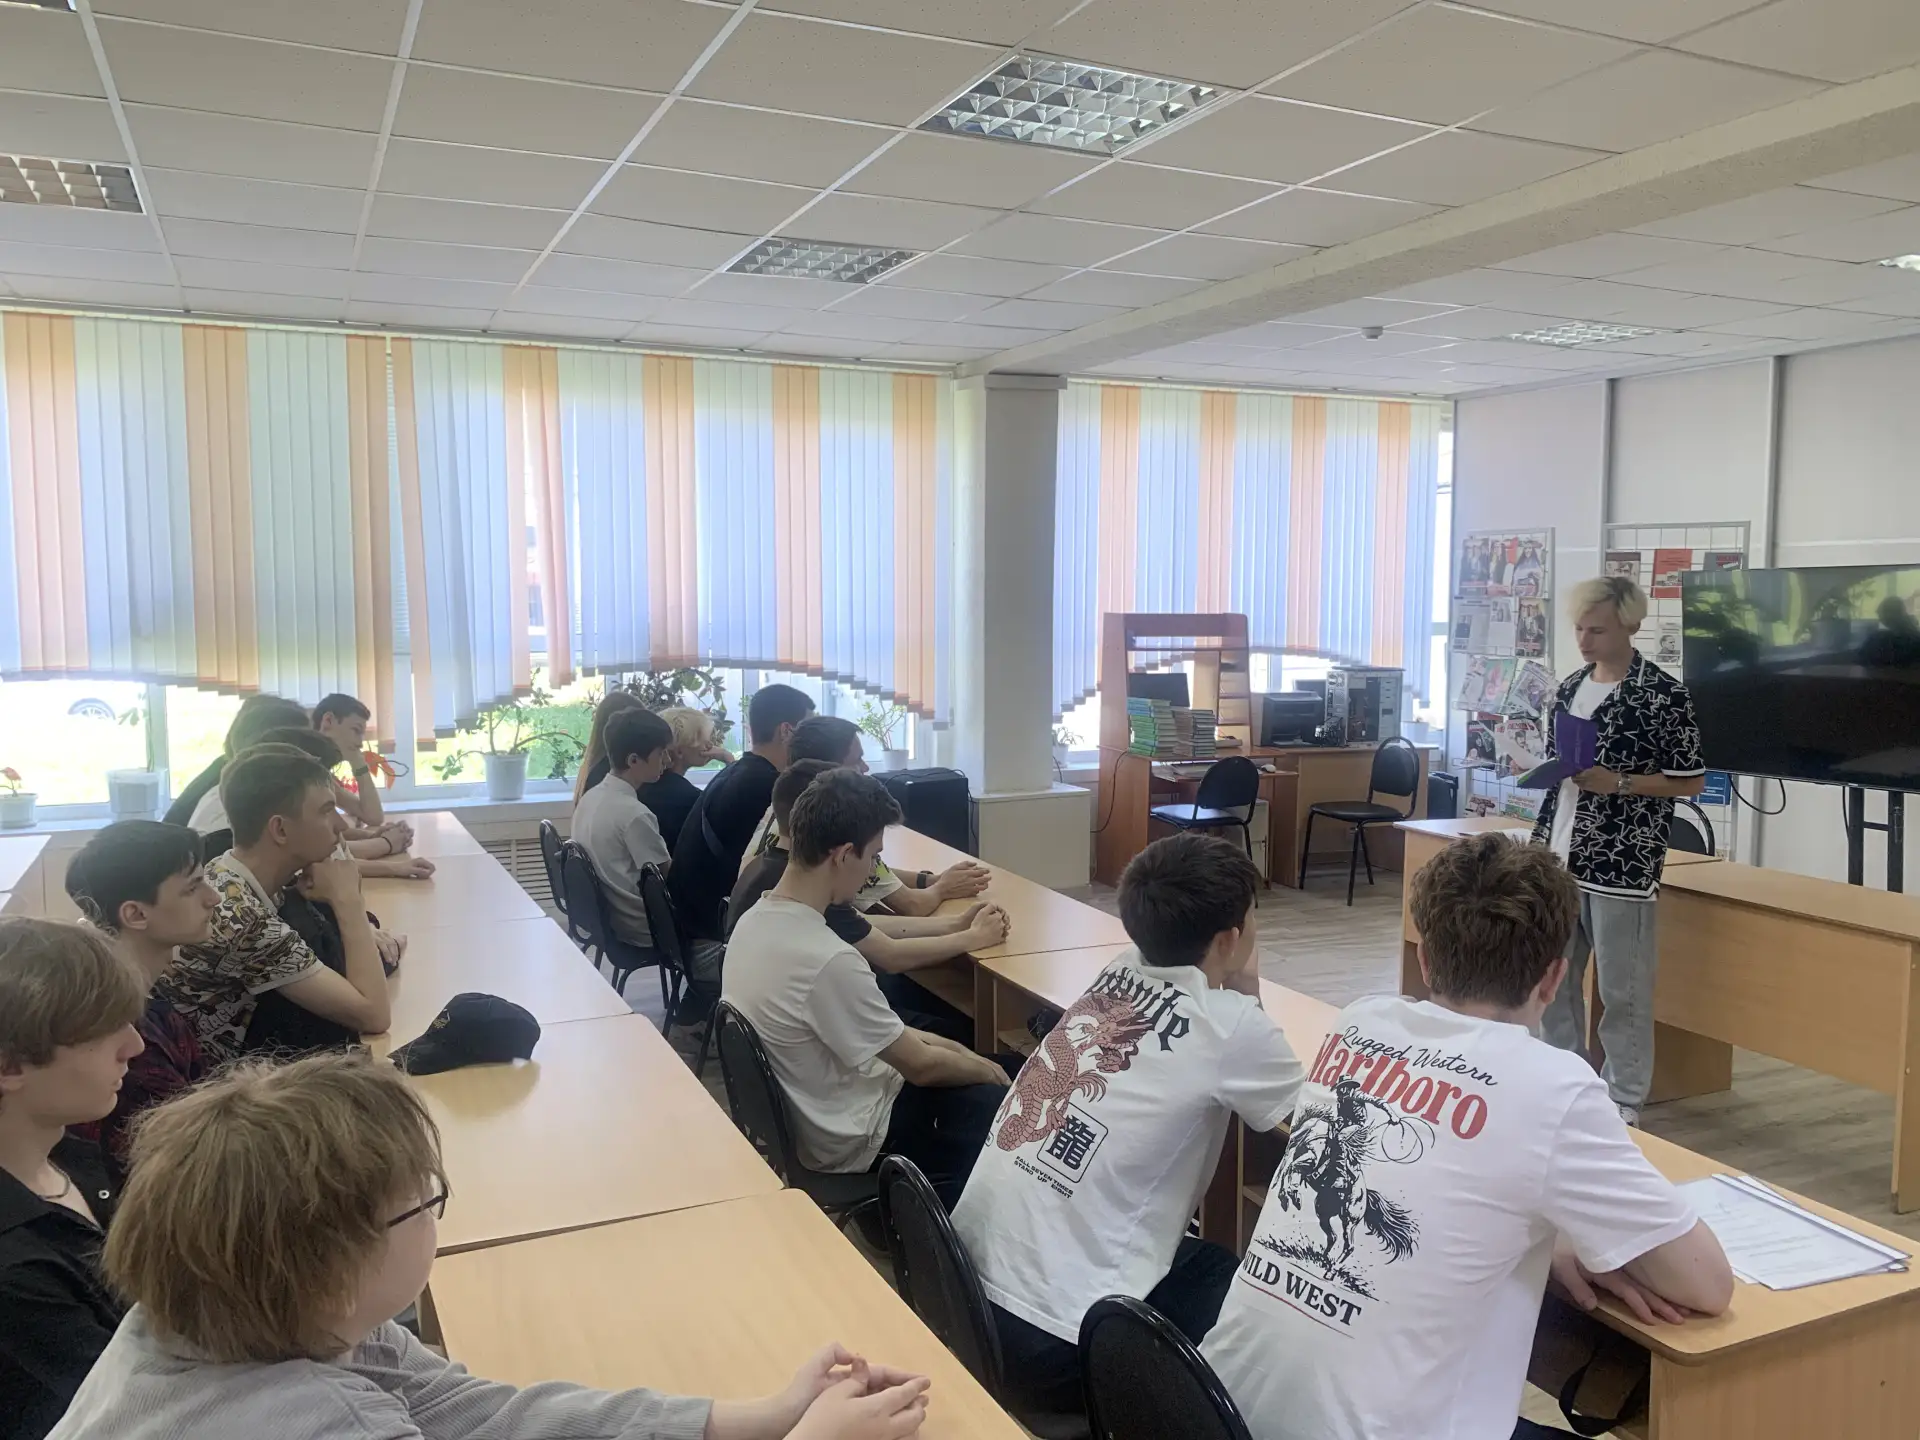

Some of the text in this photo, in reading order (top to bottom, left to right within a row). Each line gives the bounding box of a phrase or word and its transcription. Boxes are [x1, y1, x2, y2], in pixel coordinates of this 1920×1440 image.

[1305, 1033, 1488, 1140] Marlboro
[1340, 1025, 1498, 1087] Rugged Western
[1013, 1160, 1034, 1176] STAND
[1037, 1175, 1048, 1184] UP
[1015, 1155, 1074, 1195] FALL SEVEN TIMES
[1242, 1251, 1362, 1327] WILD WEST
